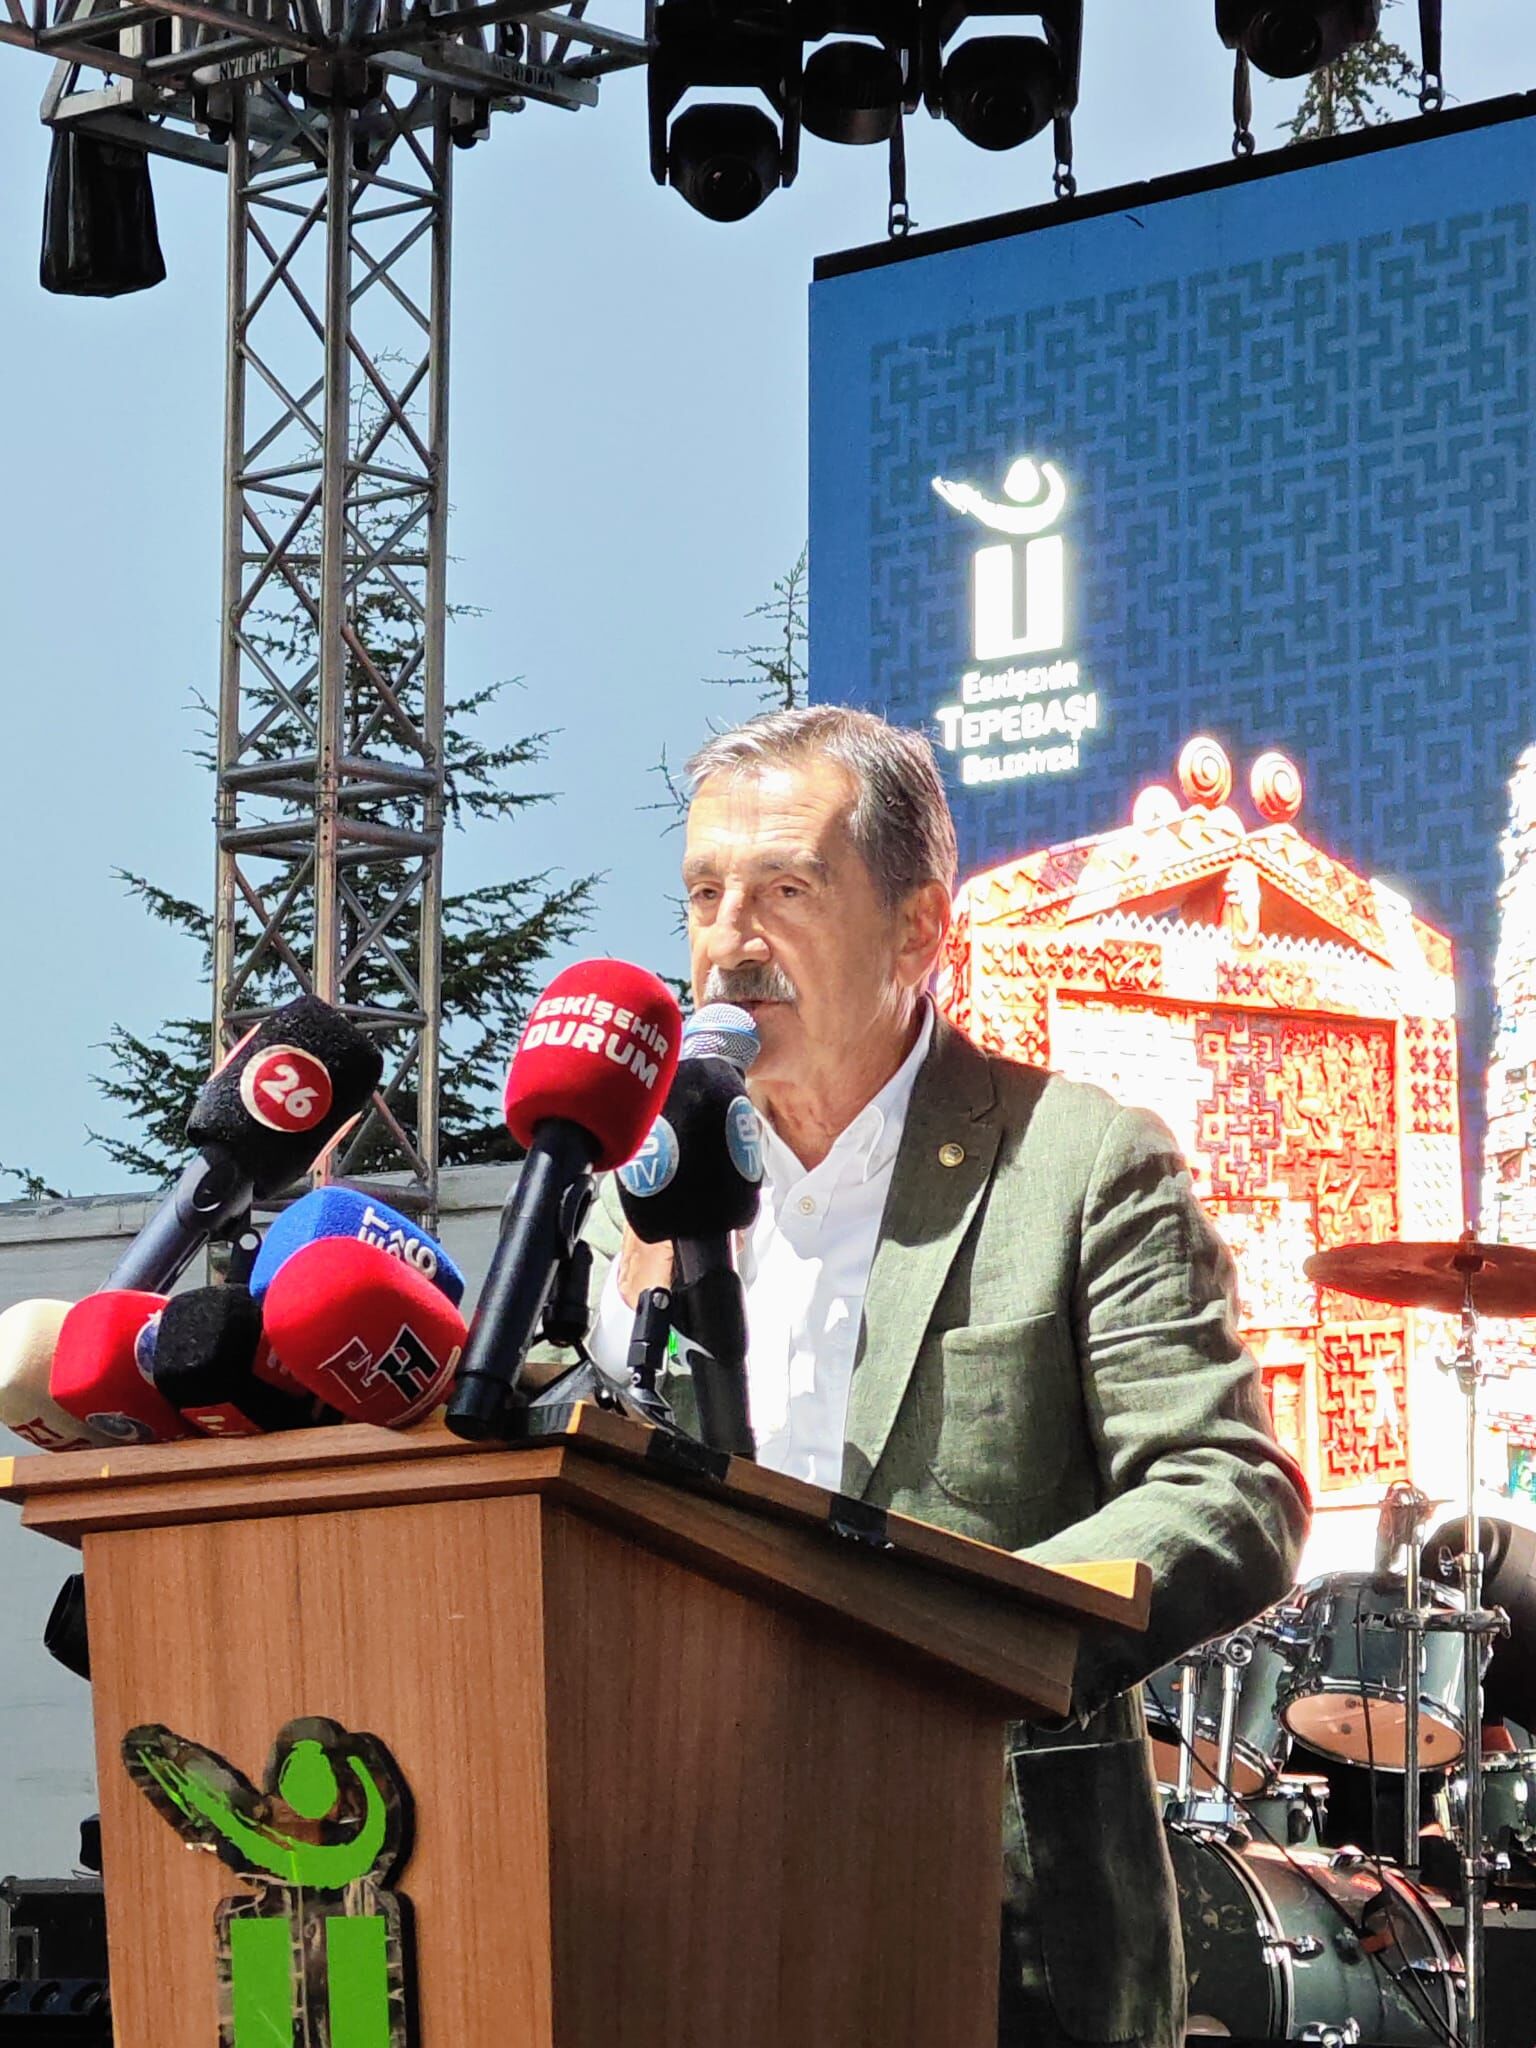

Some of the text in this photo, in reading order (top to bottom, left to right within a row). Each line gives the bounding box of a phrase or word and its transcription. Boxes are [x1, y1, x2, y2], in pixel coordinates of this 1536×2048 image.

[936, 692, 1097, 751] TEPEBAŞI
[522, 1020, 659, 1090] DURUM
[534, 993, 669, 1060] ESKİŞEHİR
[260, 1064, 319, 1118] 26
